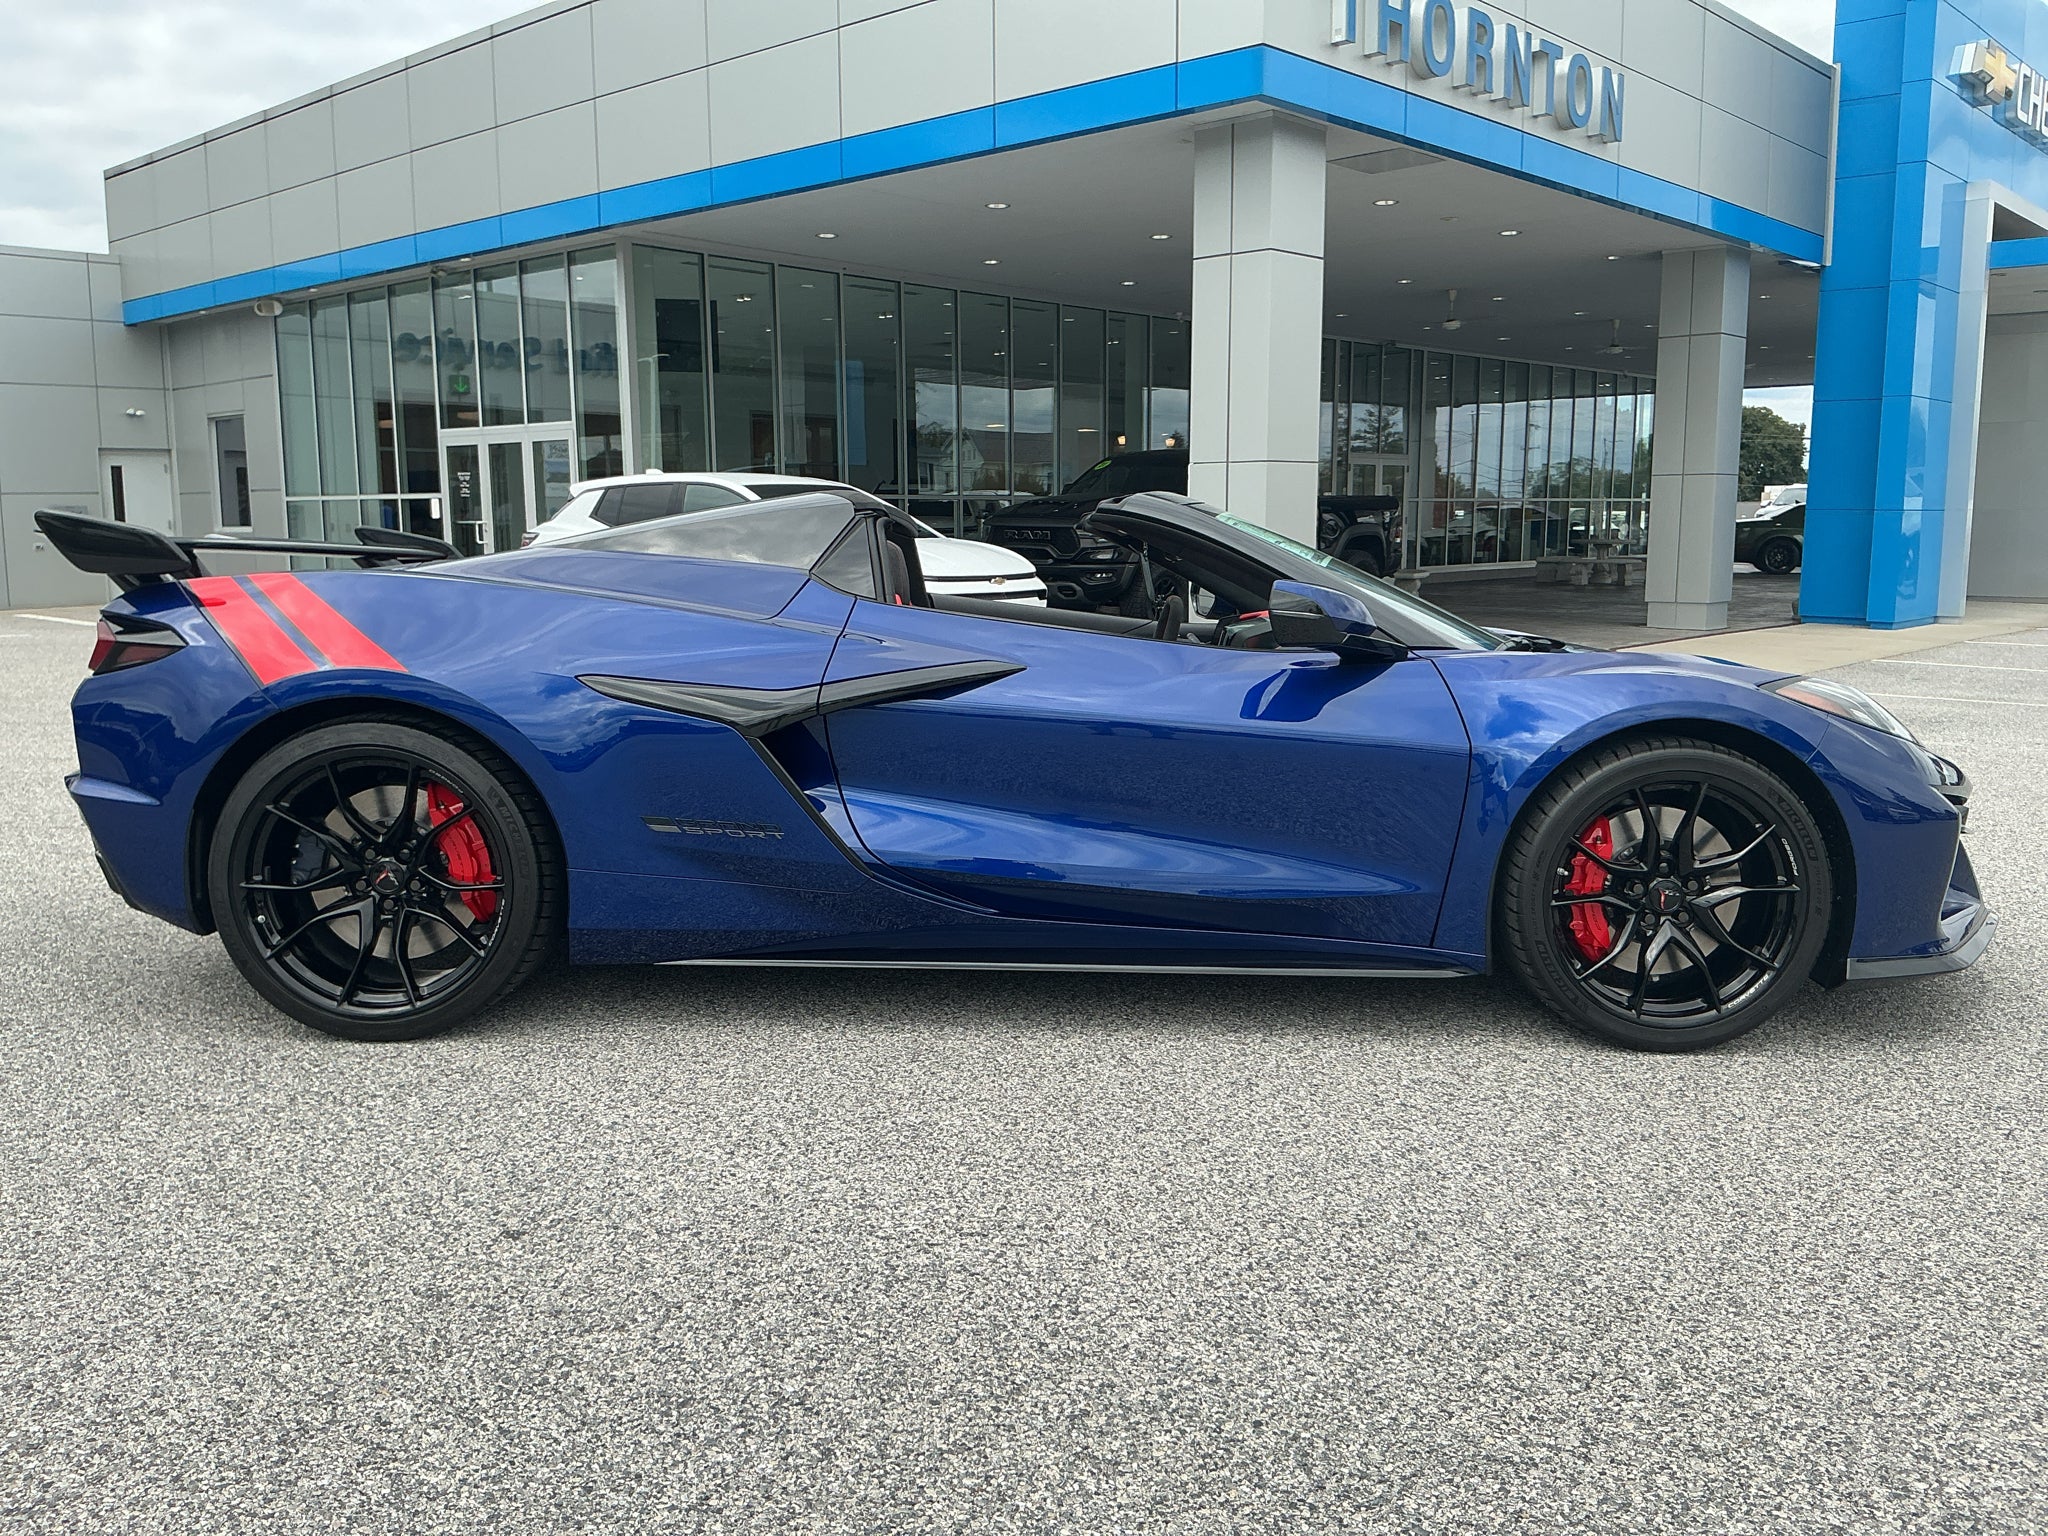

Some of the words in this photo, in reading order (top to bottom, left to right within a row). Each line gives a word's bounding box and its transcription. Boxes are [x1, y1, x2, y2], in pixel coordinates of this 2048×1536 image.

[1003, 529, 1051, 540] RAM
[682, 826, 785, 840] SPORT
[1727, 973, 1769, 1009] CORVETTE
